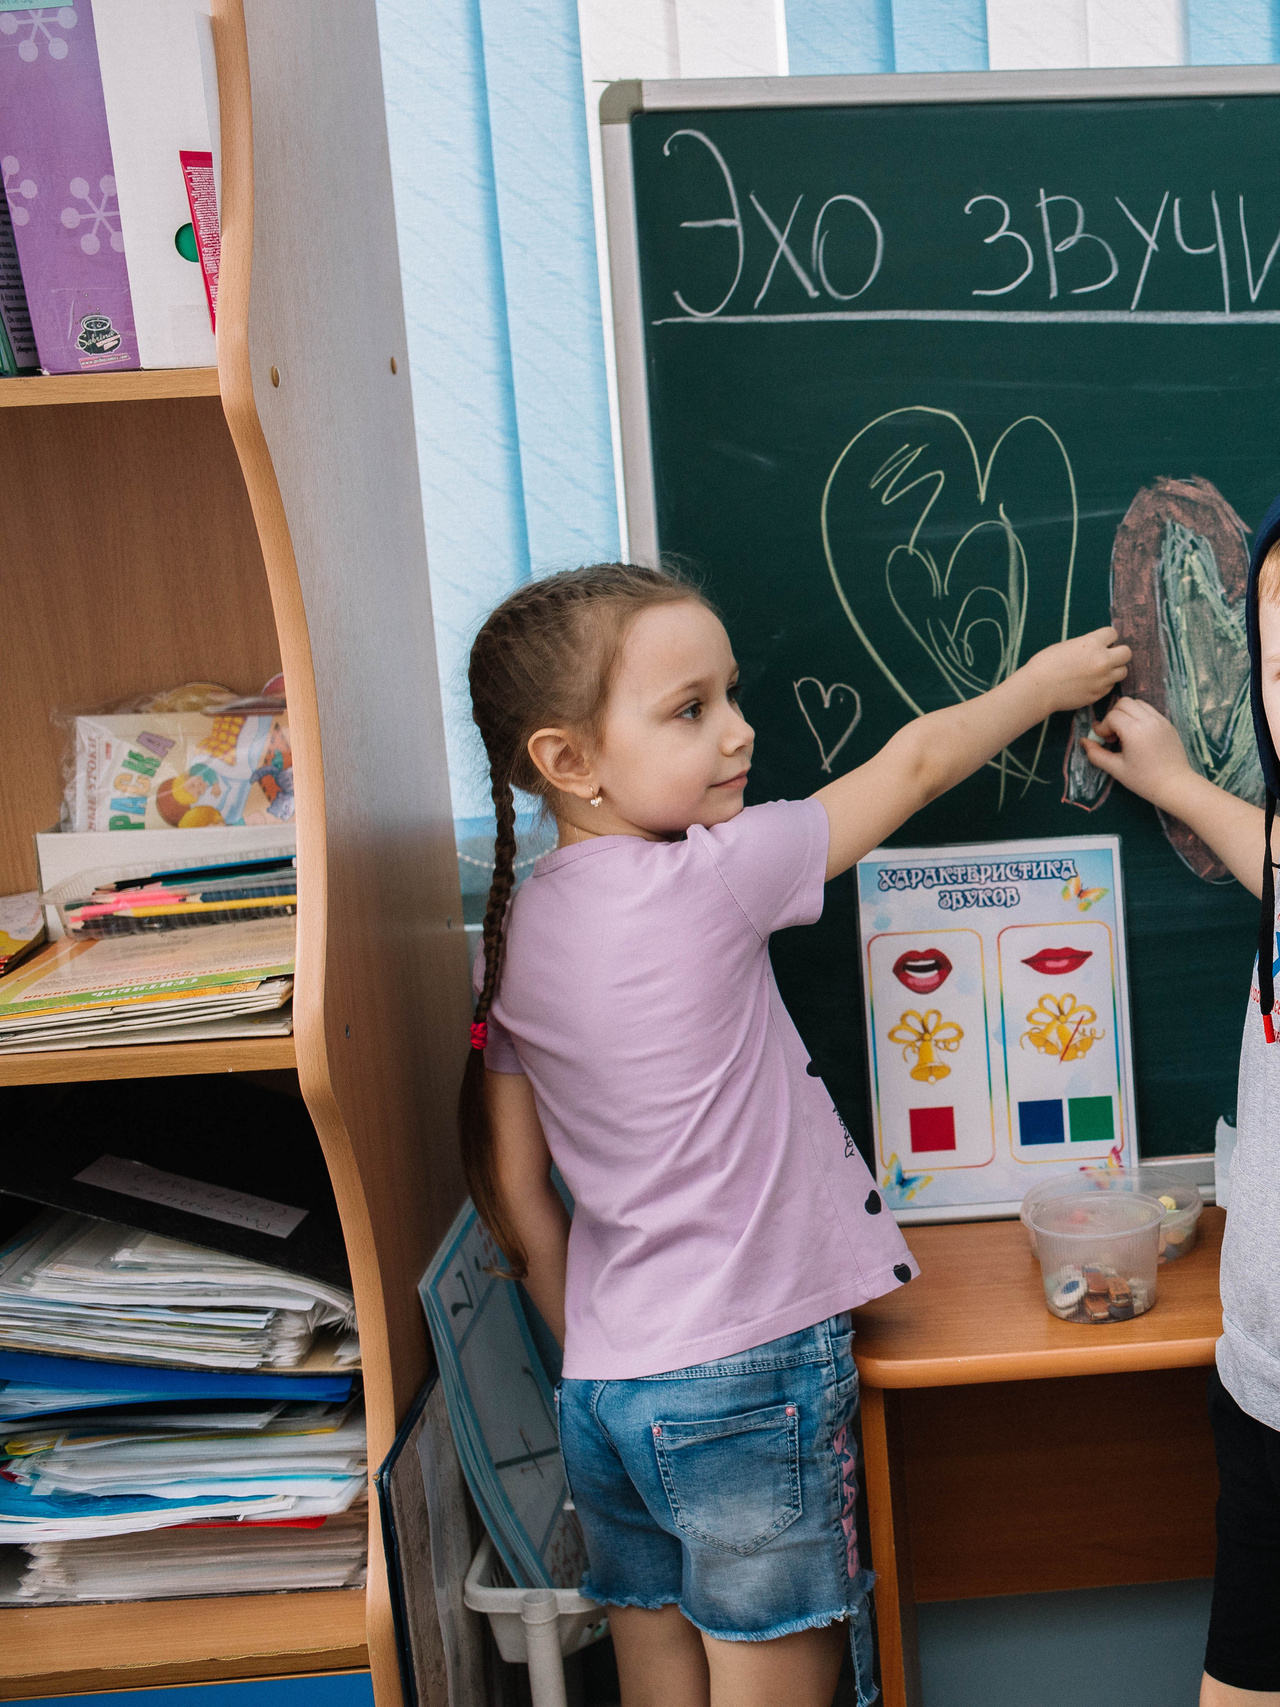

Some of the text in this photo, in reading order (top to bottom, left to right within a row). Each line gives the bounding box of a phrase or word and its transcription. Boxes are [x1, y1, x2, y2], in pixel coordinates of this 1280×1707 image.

[663, 128, 884, 318] ЭХО
[878, 859, 1079, 891] ХАРАКТЕРИСТИКА
[938, 887, 1020, 911] ЗВУКОВ
